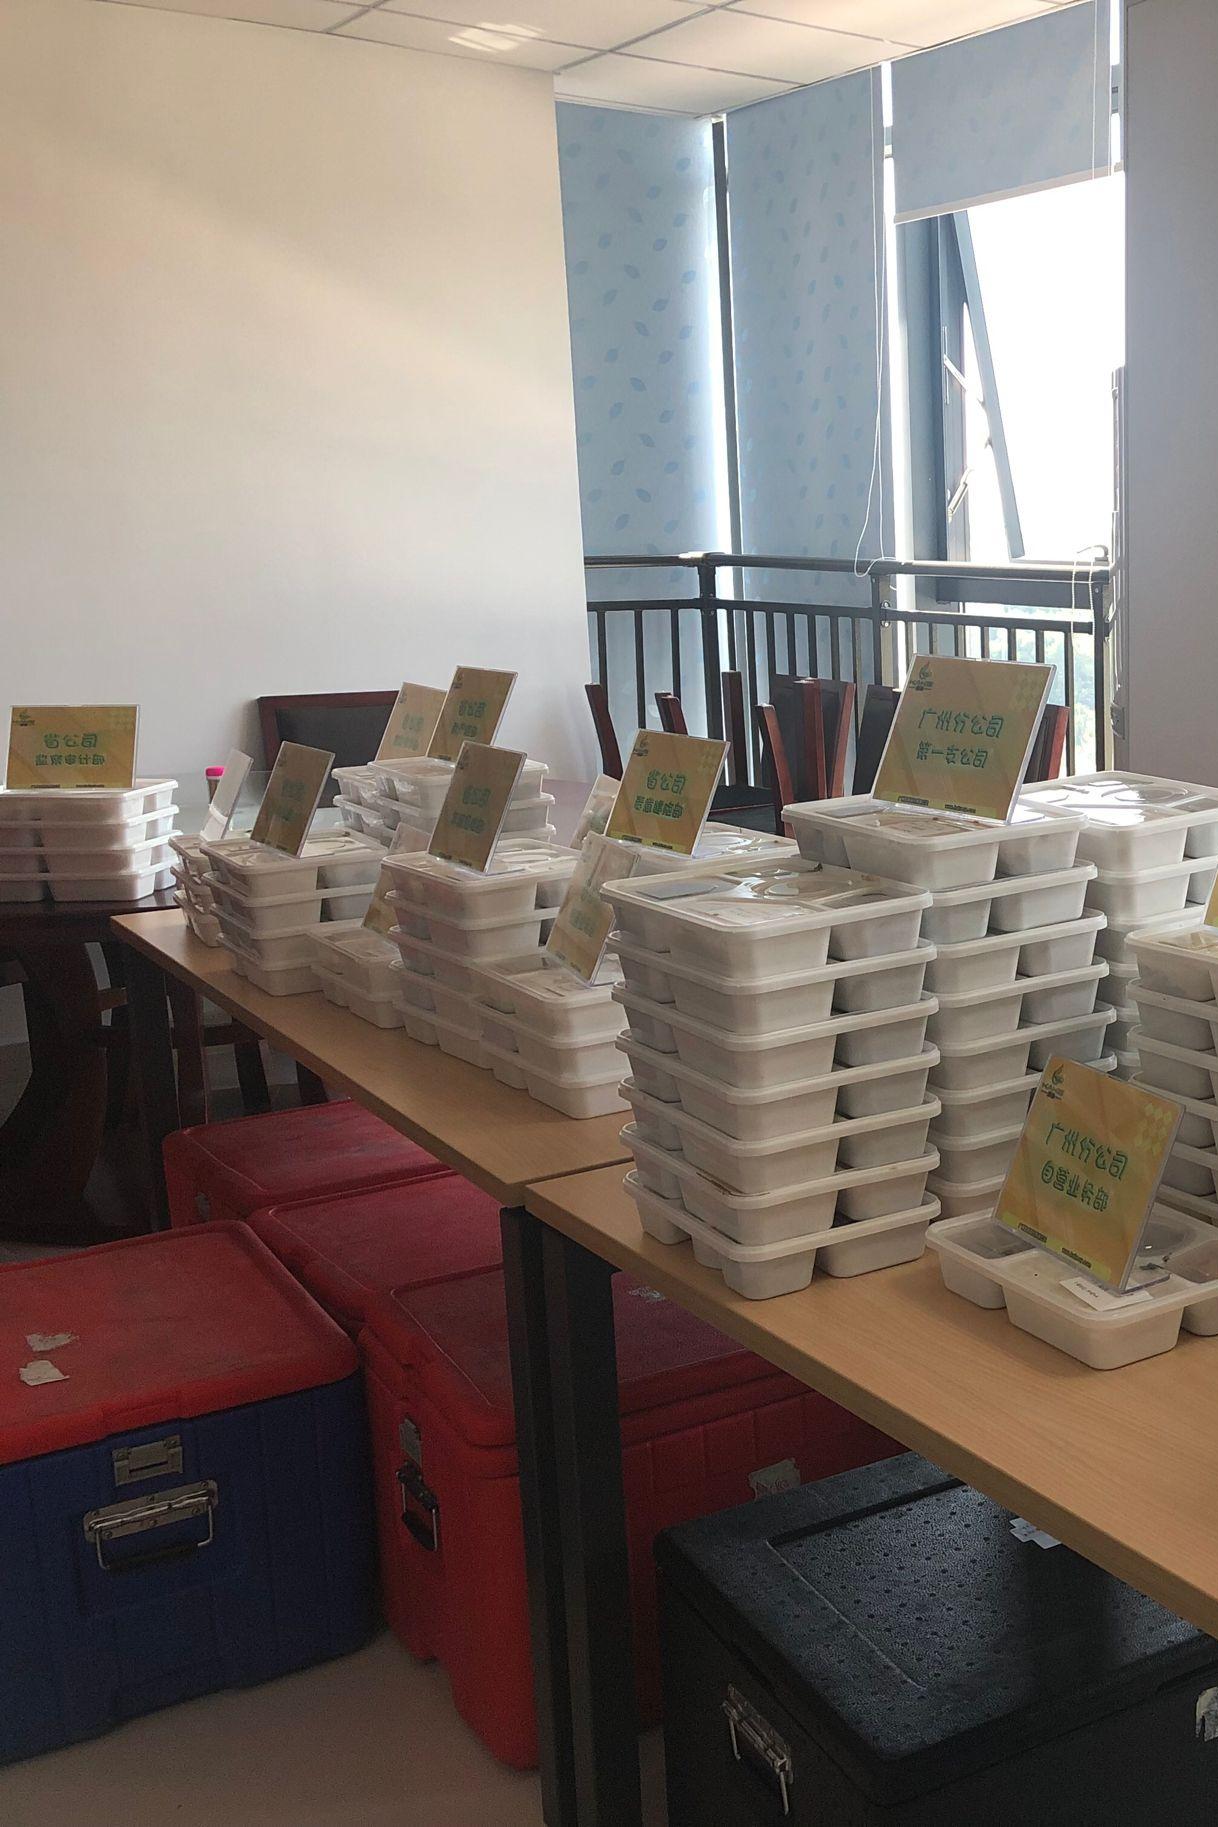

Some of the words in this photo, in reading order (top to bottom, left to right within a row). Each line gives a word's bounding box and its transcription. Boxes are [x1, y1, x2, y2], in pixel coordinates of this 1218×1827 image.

[918, 708, 1004, 738] 广州分公司
[44, 733, 97, 748] 省公司
[917, 740, 988, 769] 第一支公司
[647, 769, 686, 796] 省公司
[1045, 1123, 1129, 1180] 广州分公司
